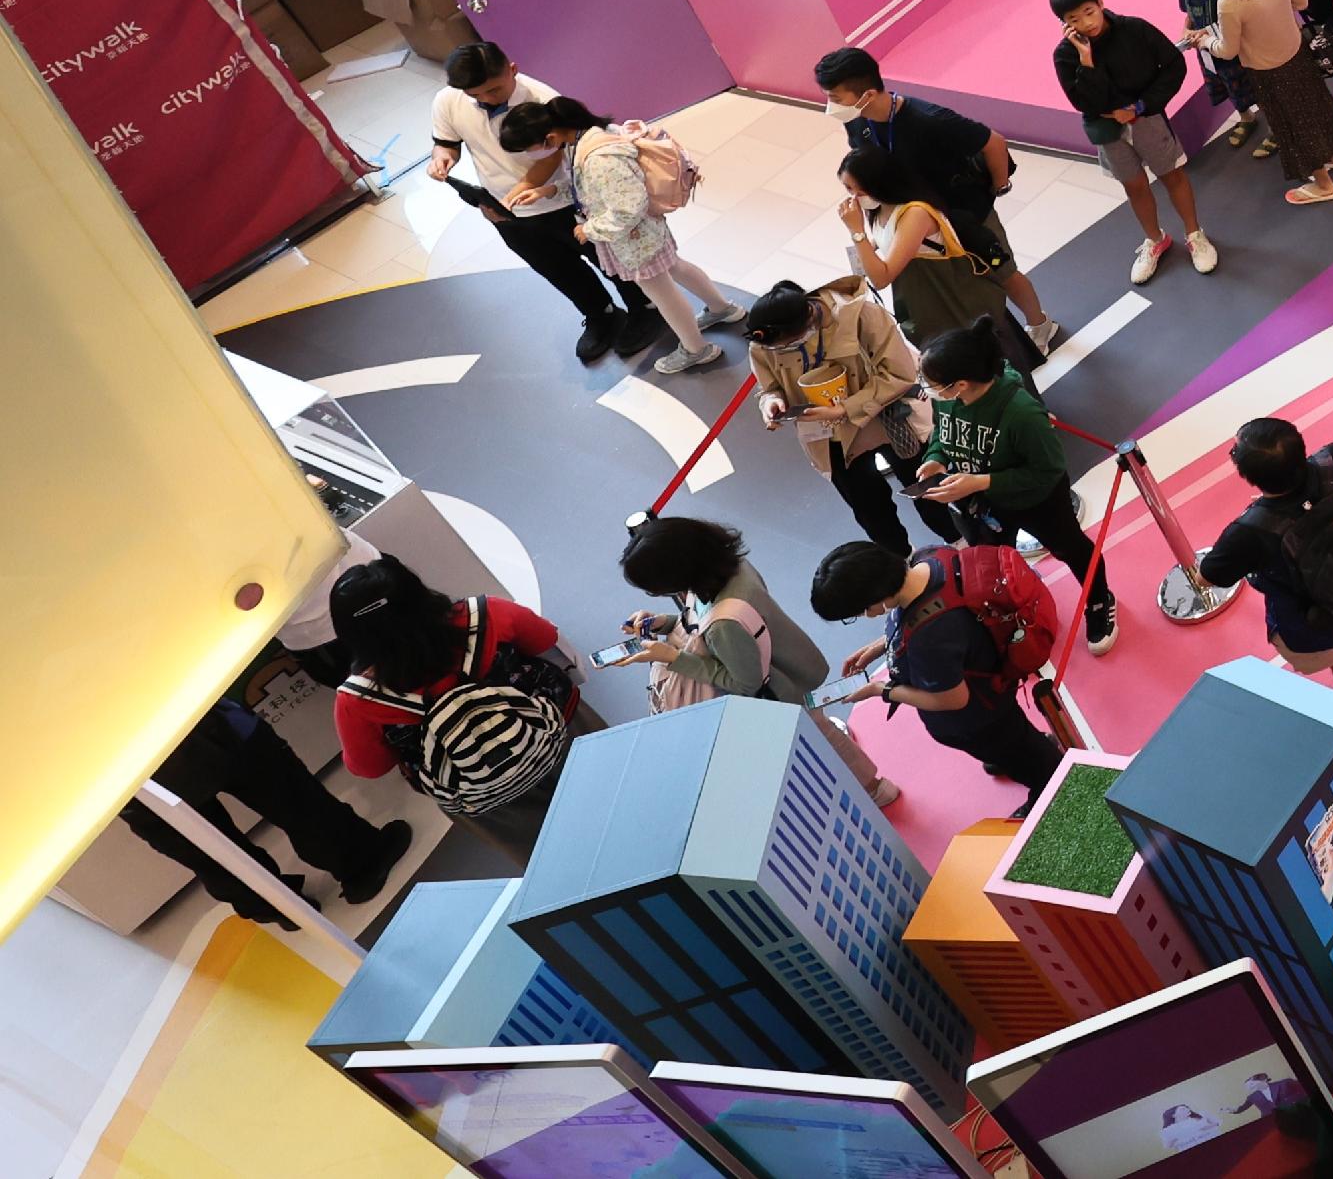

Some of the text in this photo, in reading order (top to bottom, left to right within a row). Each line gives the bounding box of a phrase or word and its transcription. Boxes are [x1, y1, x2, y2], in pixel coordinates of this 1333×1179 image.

[41, 21, 142, 83] citywalk
[161, 51, 247, 115] citywalk
[939, 412, 1000, 455] HKU
